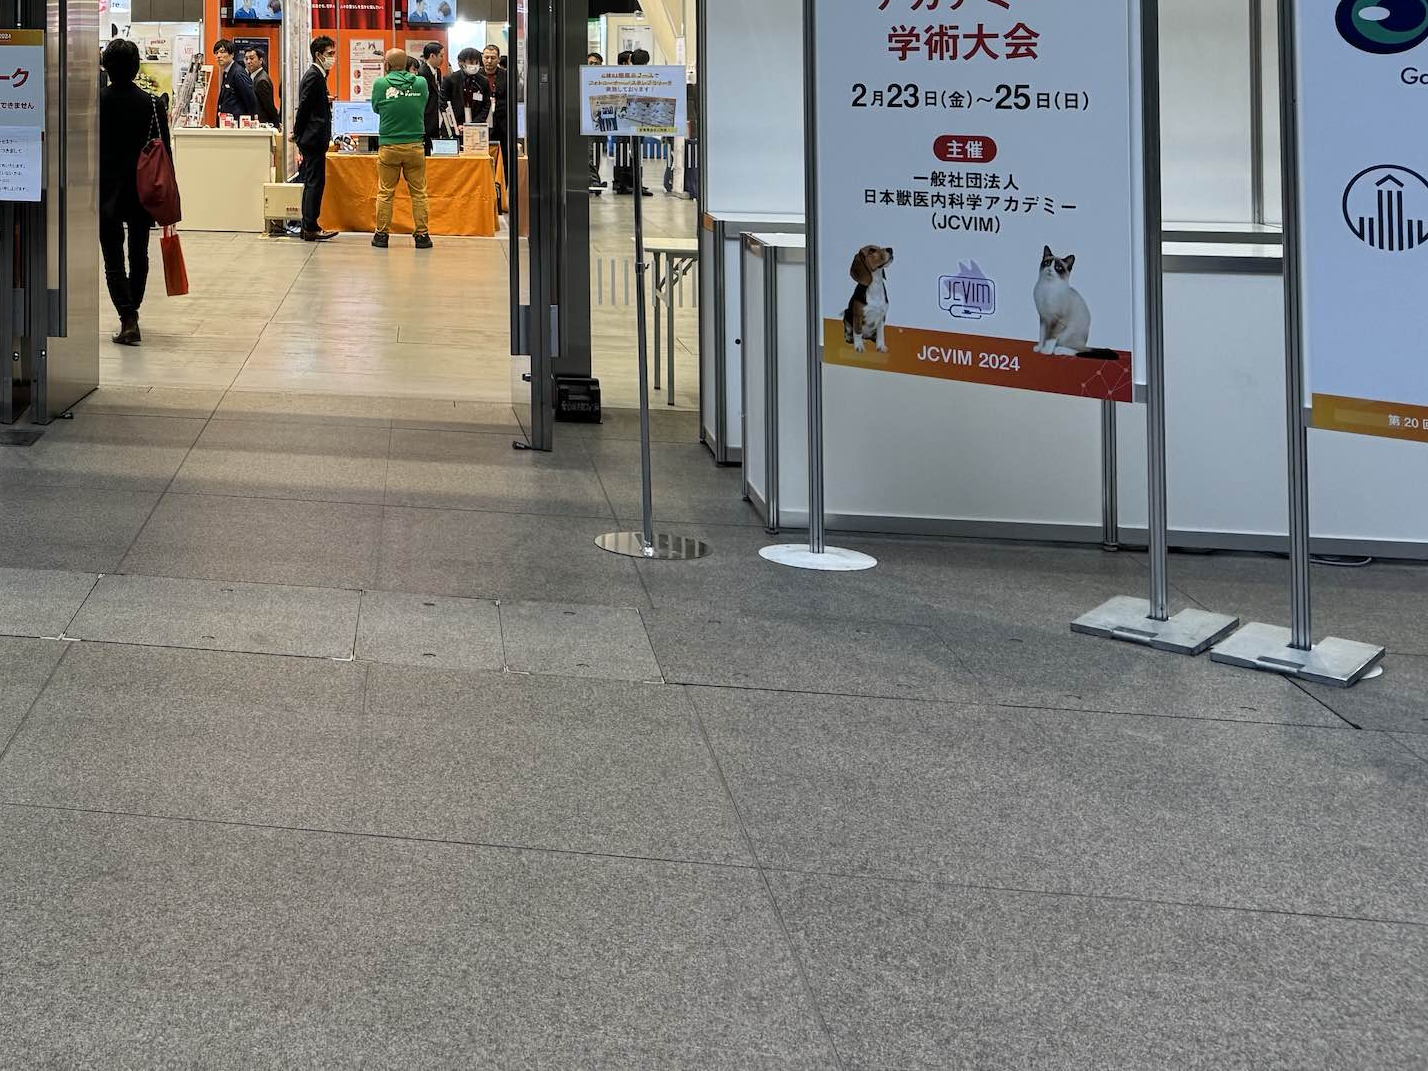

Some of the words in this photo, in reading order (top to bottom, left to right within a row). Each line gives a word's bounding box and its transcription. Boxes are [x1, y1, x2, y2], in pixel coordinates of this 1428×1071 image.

[888, 22, 1040, 61] 学術大会
[946, 140, 984, 159] 主催
[913, 170, 1019, 191] 一般社団法人
[864, 189, 1077, 215] 日本獣医内科学アカデミー
[931, 212, 1001, 234] (JCVIM)
[917, 345, 972, 366] JCVIM
[978, 352, 1021, 371] 2024
